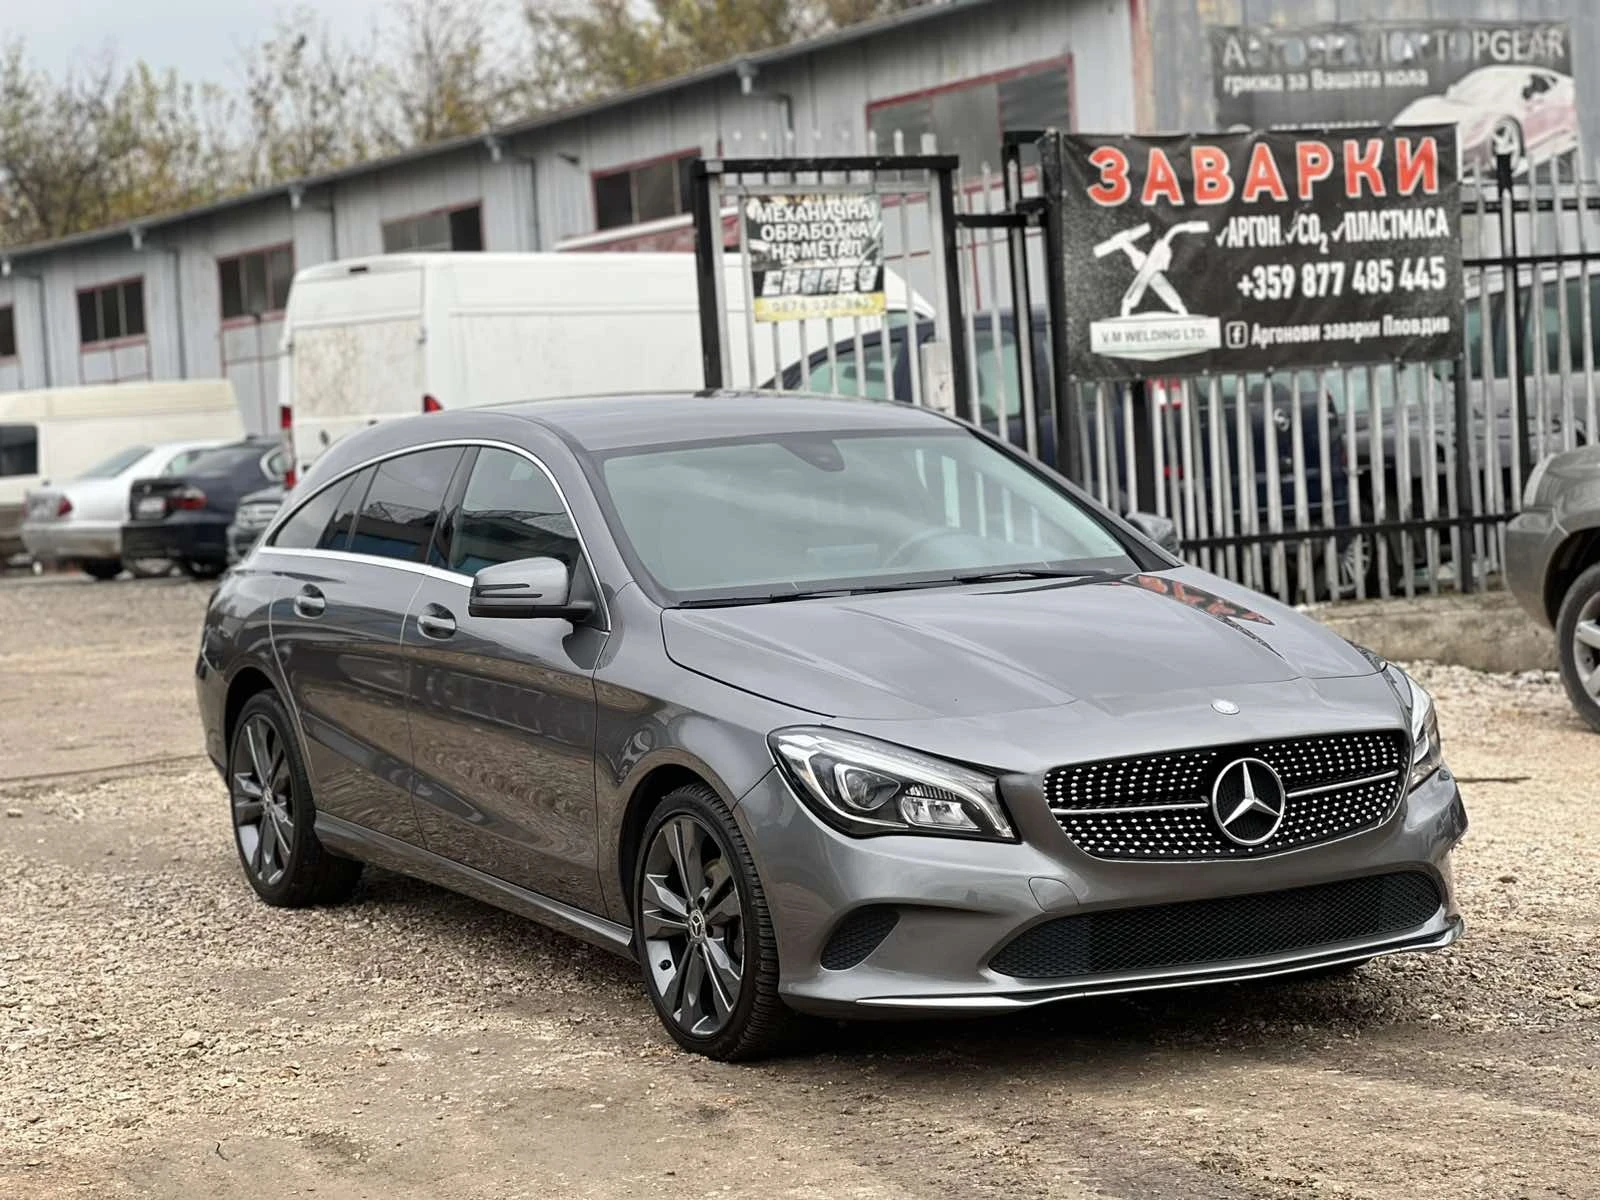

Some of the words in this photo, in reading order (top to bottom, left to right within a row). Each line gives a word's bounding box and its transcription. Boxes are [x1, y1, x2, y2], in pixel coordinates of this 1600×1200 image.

[1087, 136, 1439, 206] ЗАВАРКИ
[760, 222, 870, 242] ОБРАБОТКА
[1344, 206, 1450, 243] ПЛАСТМАСА
[771, 242, 798, 260] НА
[800, 239, 862, 259] МЕТАЛ
[1236, 264, 1296, 300] +359
[1301, 261, 1346, 297] 877
[1352, 257, 1395, 294] 485
[1399, 255, 1448, 291] 445
[1125, 327, 1181, 342] WELDING
[1250, 322, 1321, 349] Аргонови
[1322, 319, 1381, 344] заварки
[1382, 313, 1450, 337] Пловдив
